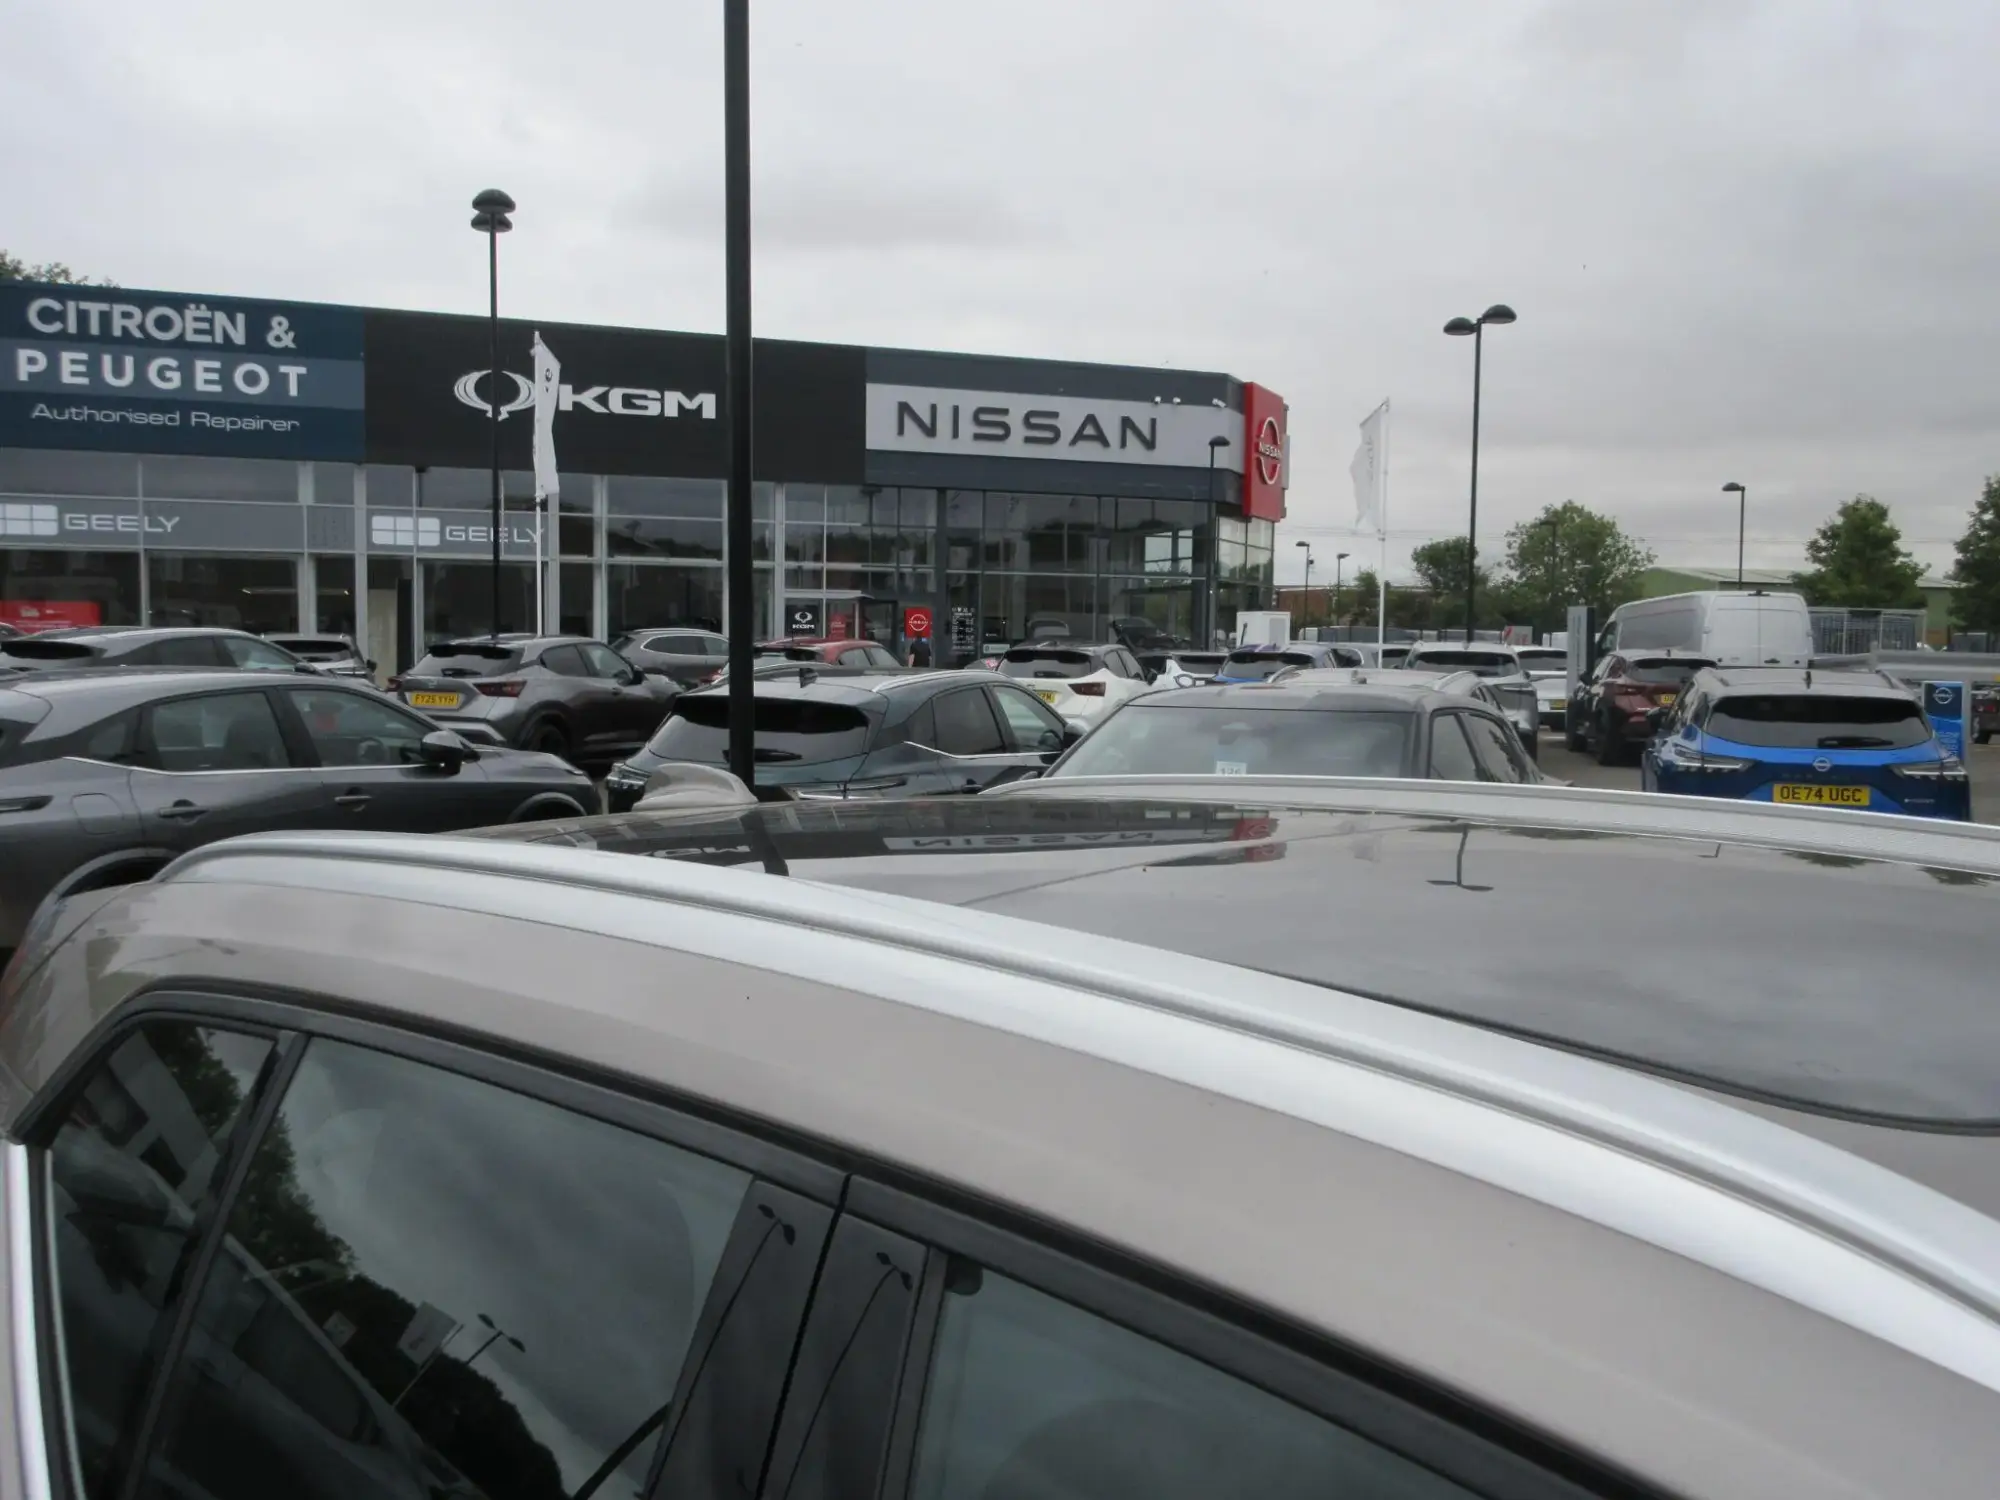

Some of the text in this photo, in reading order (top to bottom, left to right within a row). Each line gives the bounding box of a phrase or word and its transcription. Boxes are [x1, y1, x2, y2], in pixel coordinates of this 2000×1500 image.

[27, 298, 297, 348] CITROËN &
[16, 349, 307, 396] PEUGEOT
[30, 403, 300, 432] Authorised Repairer
[558, 384, 717, 419] KGM
[896, 401, 1157, 450] NISSAN
[64, 513, 180, 533] GEELY
[1780, 785, 1862, 802] OE74 UGC
